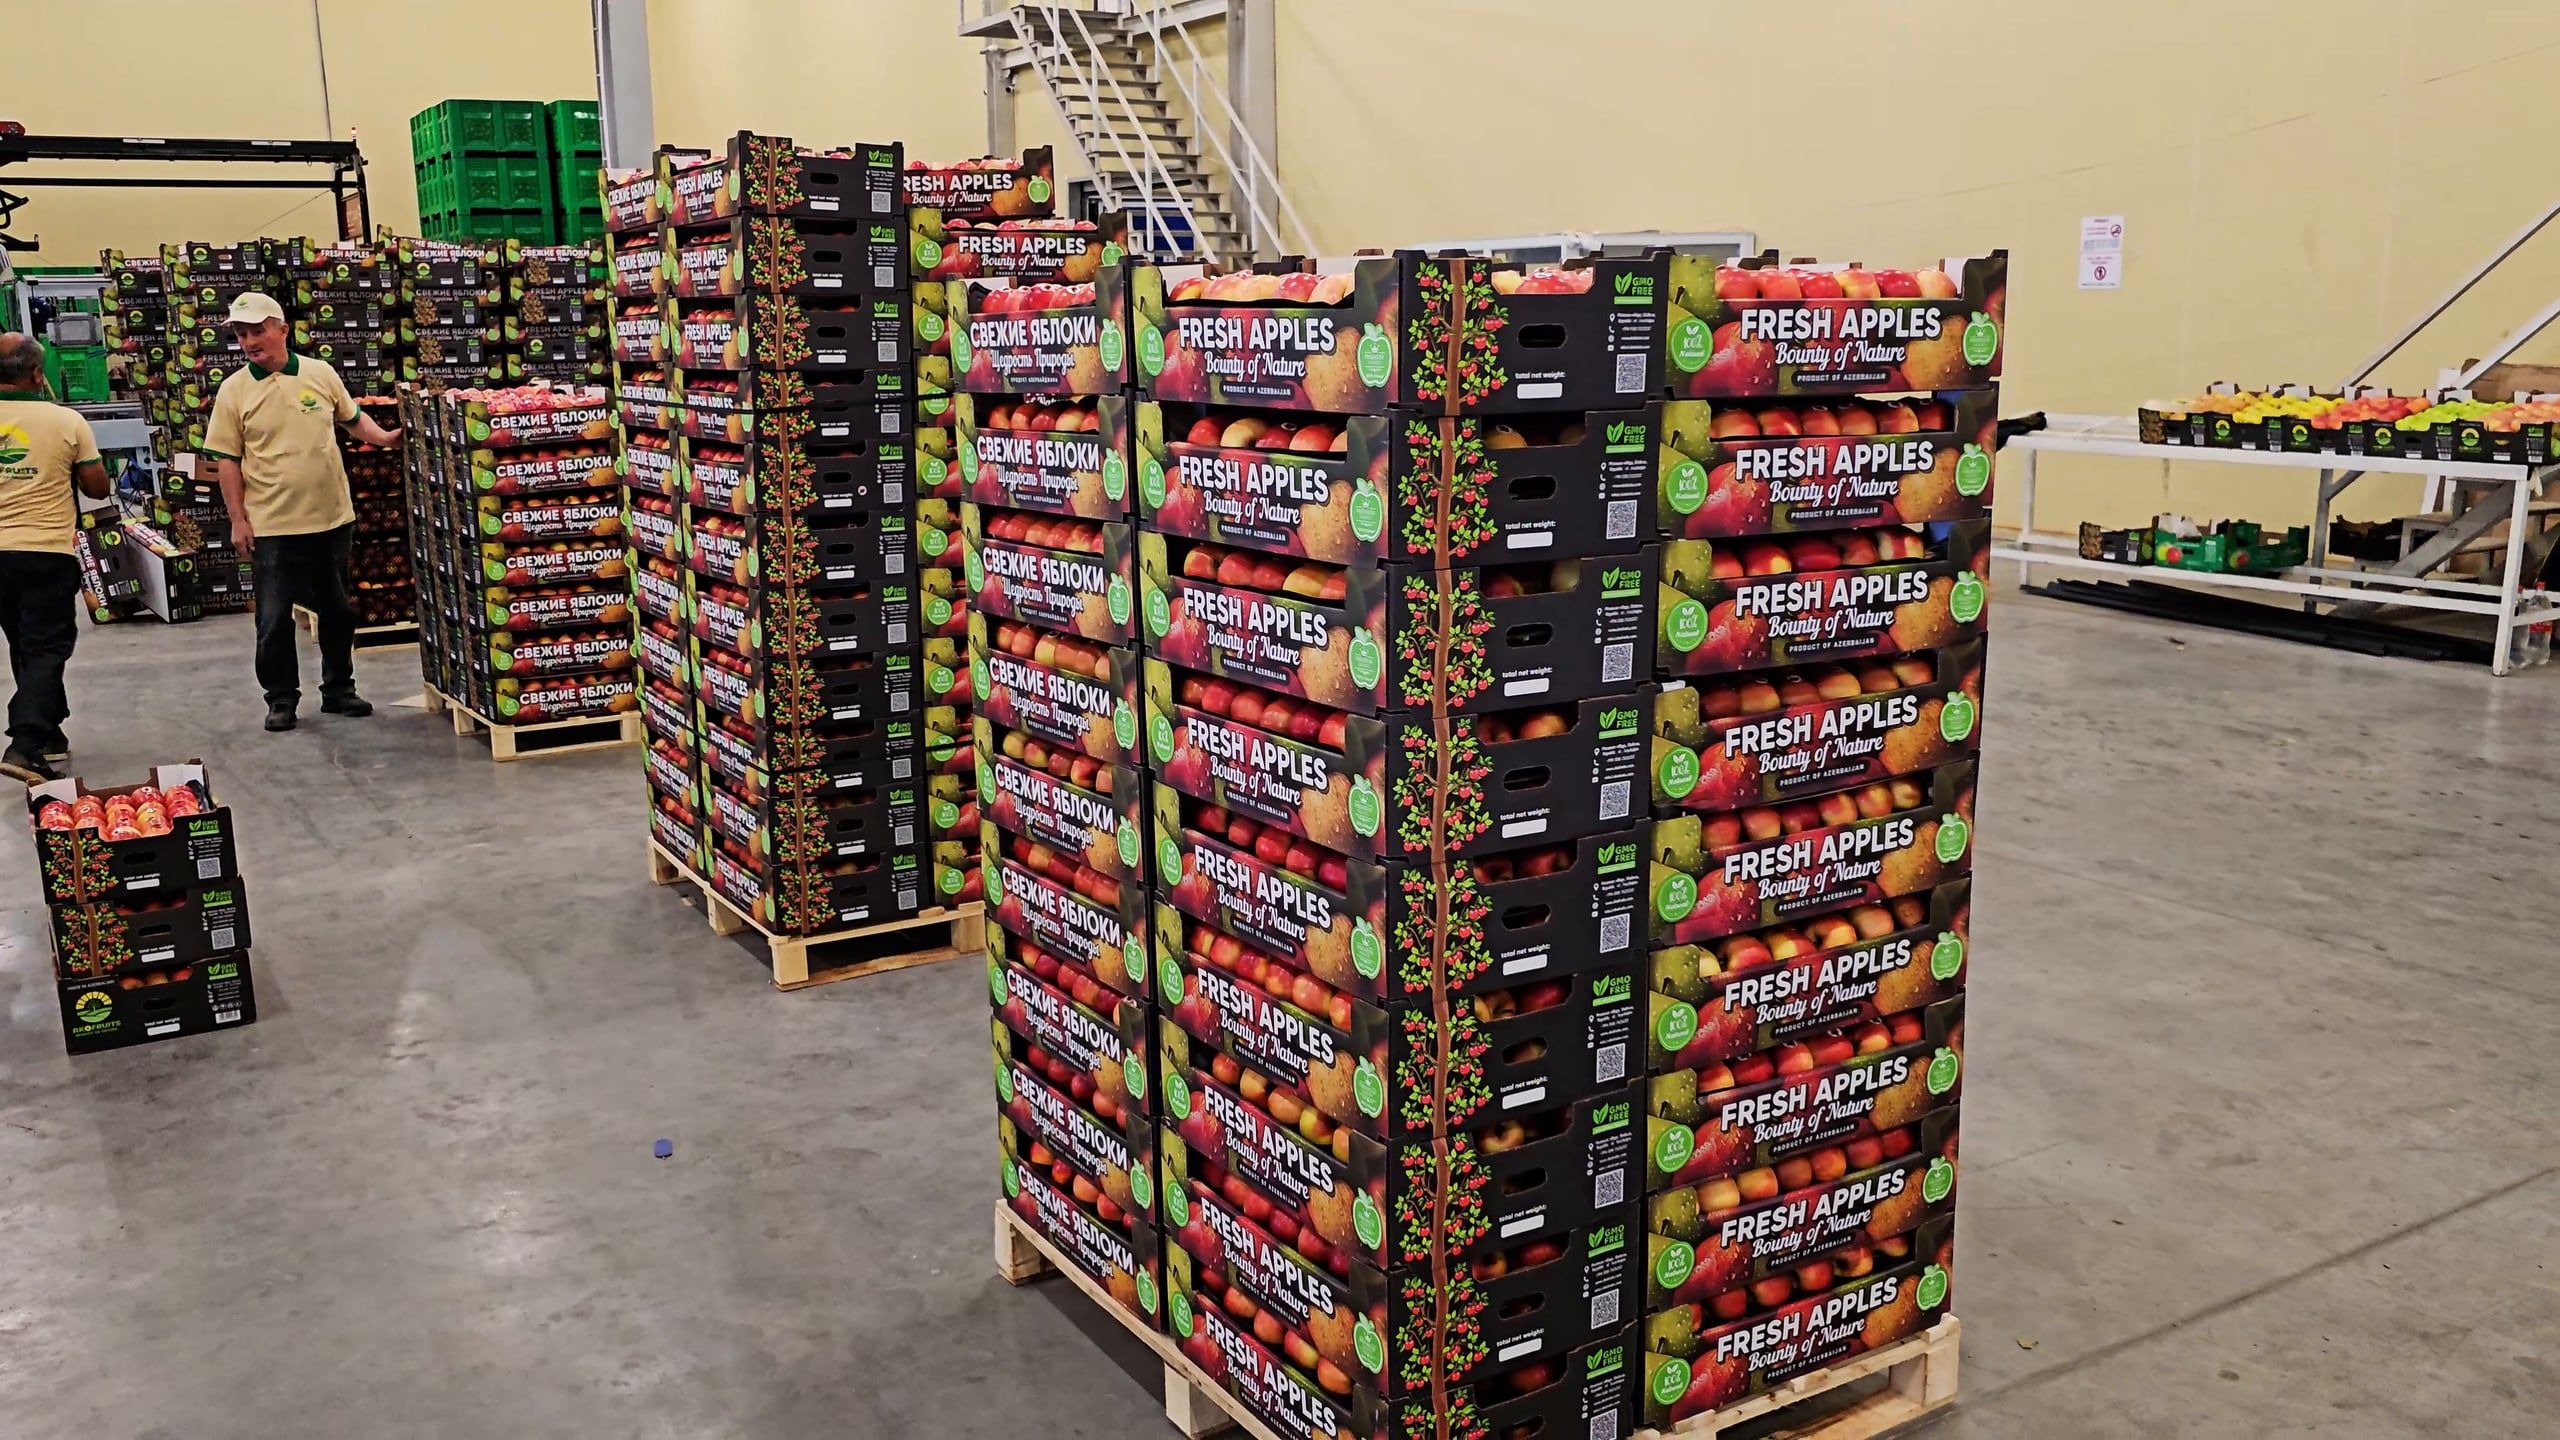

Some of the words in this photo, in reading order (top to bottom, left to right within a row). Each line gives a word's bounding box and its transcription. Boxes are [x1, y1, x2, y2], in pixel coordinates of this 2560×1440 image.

[676, 176, 696, 196] FRESH
[698, 170, 722, 190] APPLES
[903, 175, 944, 192] RESH
[949, 174, 1013, 190] APPLES
[912, 193, 945, 206] Bounty
[947, 192, 956, 206] of
[960, 191, 992, 202] Nature
[413, 250, 449, 258] СВЕЖИЕ
[450, 250, 485, 258] ЯБЛОКИ
[557, 249, 590, 257] ЯБЛОКИ
[682, 252, 702, 268] FRESH
[703, 248, 728, 267] APPLES
[959, 236, 1015, 253] FRESH
[1021, 237, 1086, 254] APPLES
[124, 259, 161, 267] СВЕЖИЕ
[981, 254, 1015, 269] Bounty
[1018, 256, 1028, 270] of
[1030, 254, 1064, 267] Nature
[557, 287, 587, 295] APPLES
[1632, 277, 1654, 287] GMO
[1632, 286, 1653, 296] FREE
[970, 319, 1028, 347] СВЕЖИЕ
[1031, 316, 1096, 347] ЯБЛОКИ
[1179, 317, 1242, 349] FRESH
[1249, 318, 1335, 351] APPLES
[1741, 308, 1831, 340] FRESH
[1839, 307, 1941, 338] APPLES
[991, 350, 1033, 375] Щедрость
[1034, 349, 1075, 375] Природы
[1204, 352, 1245, 382] Bounty
[1248, 356, 1260, 382] of
[1262, 352, 1306, 378] Nature
[1775, 343, 1831, 369] Bounty
[1834, 344, 1849, 370] of
[1853, 341, 1906, 362] Nature
[490, 413, 548, 429] СВЕЖИЕ
[552, 409, 606, 423] ЯБЛОКИ
[977, 436, 1033, 465] СВЕЖИЕ
[1036, 441, 1099, 471] ЯБЛОКИ
[694, 464, 714, 482] FRESH
[715, 468, 739, 486] APPLES
[996, 464, 1038, 492] Щедрость
[1040, 470, 1079, 497] Природы
[502, 509, 559, 523] СВЕЖИЕ
[563, 506, 618, 520] ЯБЛОКИ
[76, 530, 95, 569] СВЕЖИЕ
[88, 568, 108, 607] ЯБЛОКИ
[1620, 570, 1642, 580] GMO
[1619, 579, 1641, 589] FREE
[1736, 580, 1822, 616] FRESH
[1829, 571, 1929, 607] APPLES
[509, 599, 566, 613] СВЕЖИЕ
[570, 594, 624, 608] ЯБЛОКИ
[1768, 613, 1822, 639] Bounty
[1825, 612, 1839, 638] of
[1844, 607, 1894, 629] Nature
[520, 689, 576, 704] СВЕЖИЕ
[579, 683, 633, 699] ЯБЛОКИ
[989, 657, 1045, 697] СВЕЖИЕ
[1048, 674, 1111, 716] ЯБЛОКИ
[1009, 688, 1049, 717] Щедрость
[1051, 702, 1090, 736] Природы
[1188, 718, 1244, 763] FRESH
[1250, 739, 1328, 790] APPLES
[1210, 755, 1246, 790] Bounty
[1250, 772, 1260, 797] of
[1262, 774, 1302, 806] Nature
[1724, 965, 1810, 1011] FRESH
[1817, 939, 1911, 984] APPLES
[1756, 1000, 1806, 1024] Bounty
[1810, 989, 1824, 1015] of
[1828, 980, 1877, 1005] Nature
[1198, 968, 1254, 1018] FRESH
[1259, 996, 1334, 1065] APPLES
[1220, 1009, 1256, 1048] Bounty
[1258, 1033, 1269, 1064] of
[1270, 1038, 1310, 1074] Nature
[1604, 1233, 1624, 1245] FREE
[1605, 1225, 1624, 1237] GMO
[1717, 1313, 1801, 1362] FRESH
[1806, 1277, 1898, 1328] APPLES
[1497, 1338, 1511, 1347] total
[1513, 1335, 1523, 1344] net
[1748, 1345, 1798, 1372] Bounty
[1802, 1332, 1817, 1358] of
[1818, 1319, 1865, 1346] Nature
